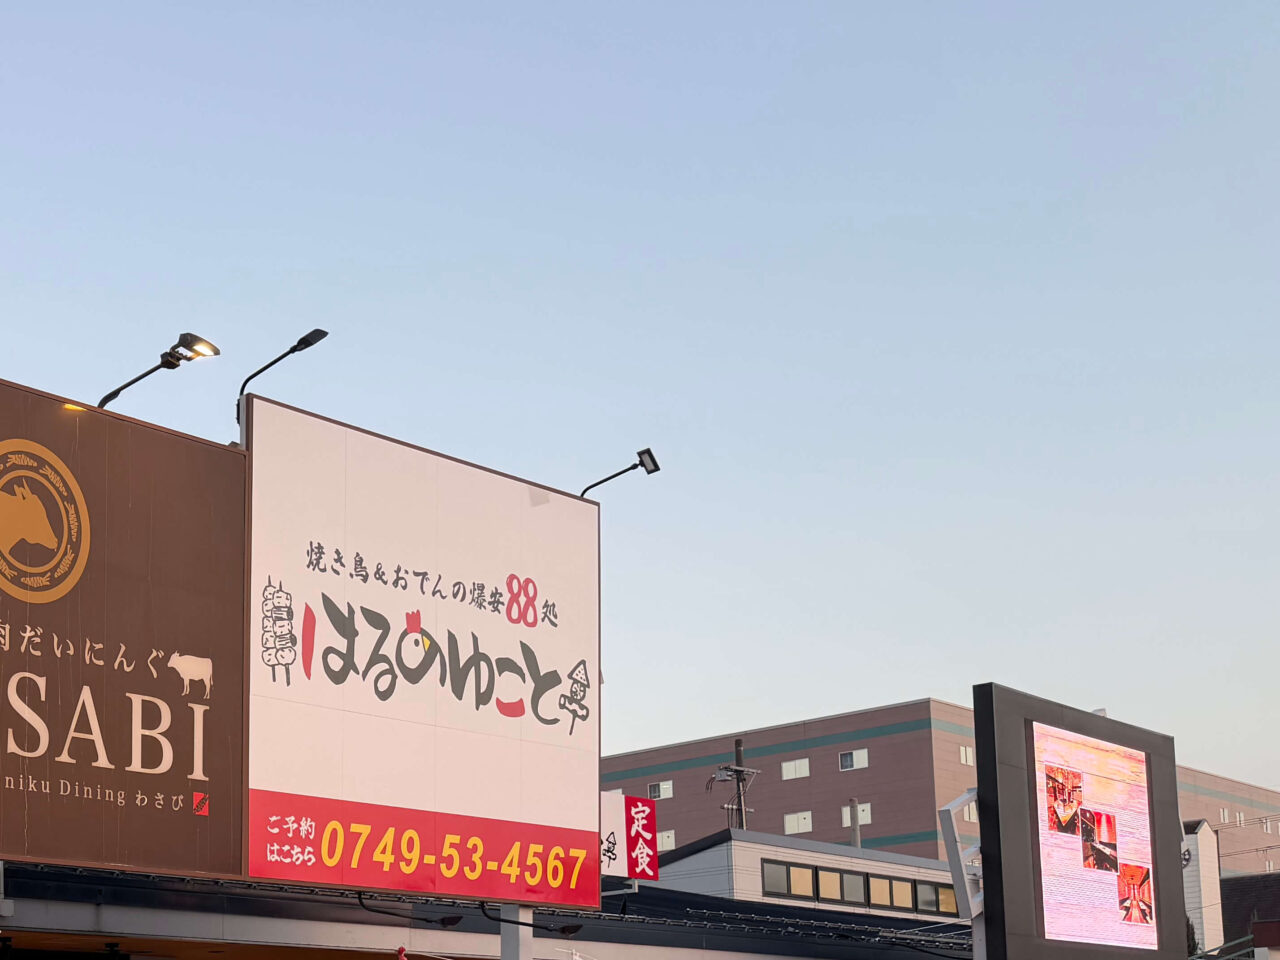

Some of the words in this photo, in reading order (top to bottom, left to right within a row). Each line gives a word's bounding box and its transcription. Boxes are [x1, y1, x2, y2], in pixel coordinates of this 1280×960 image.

[59, 780, 126, 807] Dining
[135, 790, 184, 812] わさび
[267, 815, 316, 840] ご予約
[630, 801, 654, 876] 定食
[266, 843, 316, 867] はこちら
[320, 820, 587, 889] 0749-53-4567
